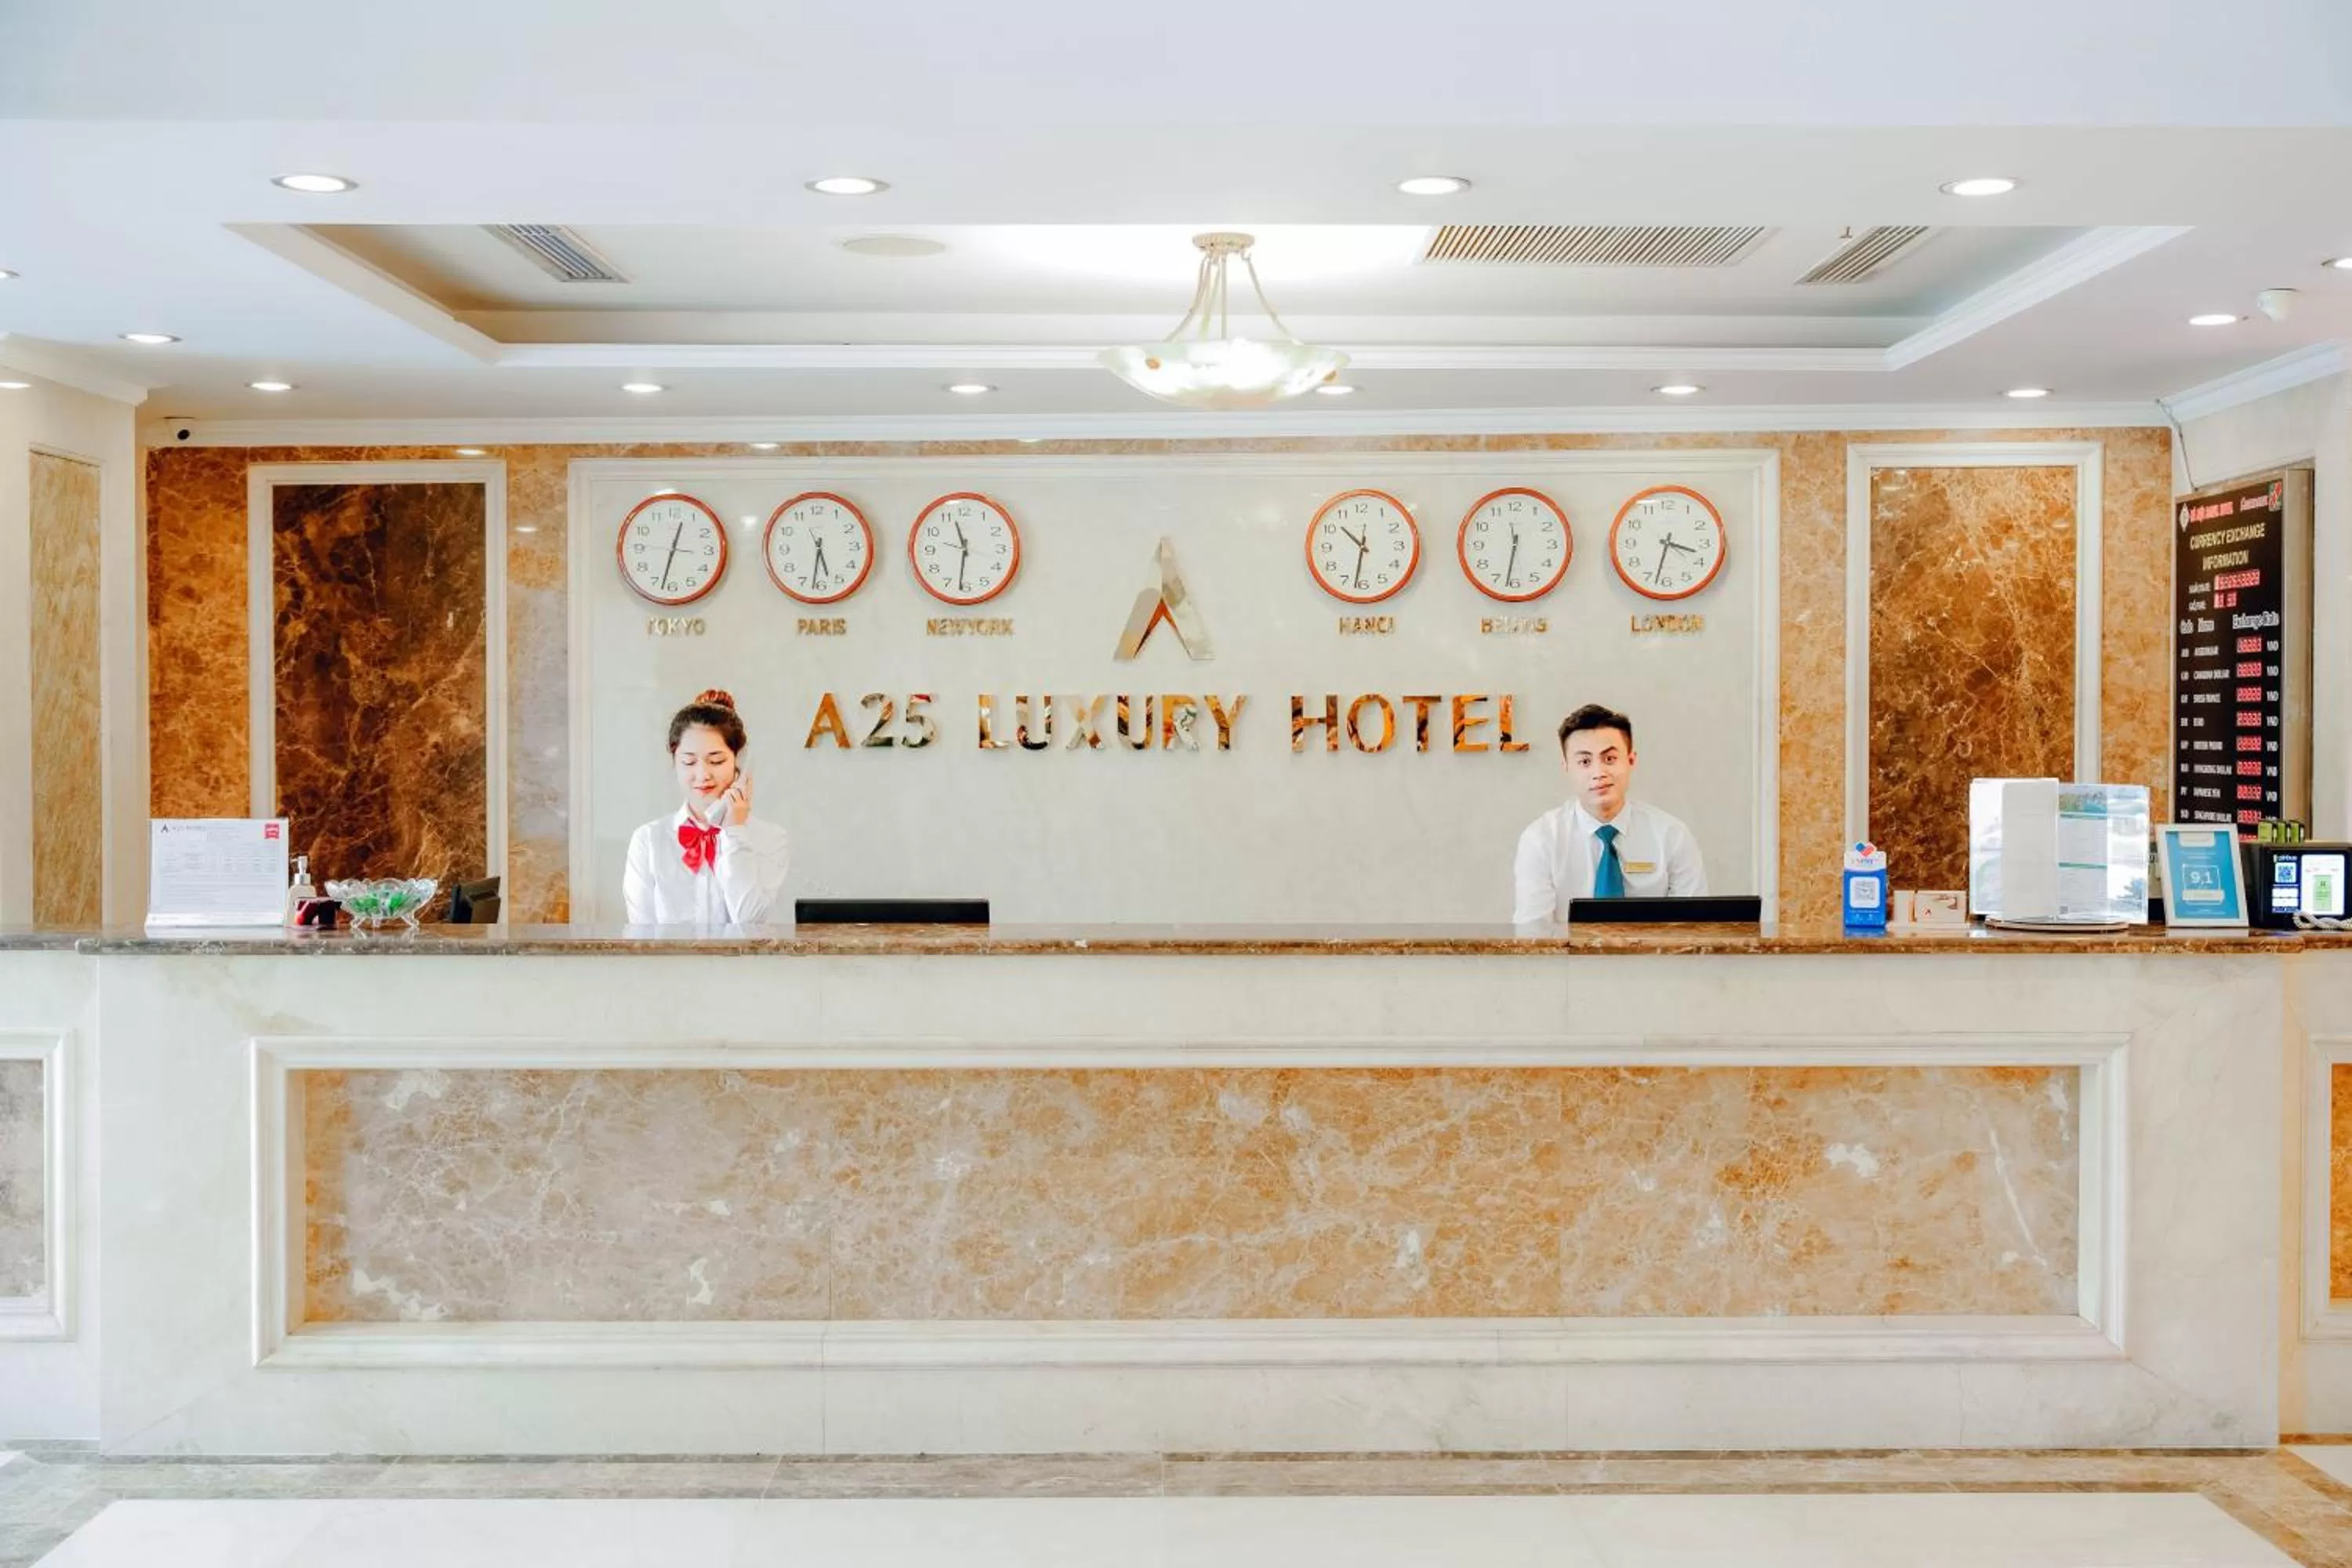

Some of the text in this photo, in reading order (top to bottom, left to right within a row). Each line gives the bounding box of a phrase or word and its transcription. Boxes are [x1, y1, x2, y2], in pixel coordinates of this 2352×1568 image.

[810, 505, 824, 515] 12
[1355, 503, 1368, 514] 12
[1508, 502, 1522, 512] 12
[1644, 505, 1653, 514] 11
[1661, 501, 1675, 510] 12
[652, 512, 662, 522] 11
[669, 508, 682, 519] 12
[794, 511, 804, 521] 11
[941, 512, 951, 522] 11
[958, 508, 971, 517] 12
[1338, 510, 1348, 518] 11
[1492, 507, 1501, 517] 11
[844, 524, 854, 534] 2
[1323, 524, 1336, 534] 10
[1388, 523, 1399, 534] 2
[1475, 521, 1489, 532] 10
[1542, 521, 1553, 532] 2
[1628, 519, 1641, 530] 10
[1694, 521, 1705, 531] 2
[637, 526, 649, 536] 10
[699, 528, 710, 539] 2
[782, 526, 793, 536] 10
[927, 527, 939, 537] 10
[991, 527, 1001, 536] 2
[849, 541, 860, 551] 3
[1321, 543, 1332, 553] 9
[1394, 540, 1404, 551] 3
[1473, 540, 1484, 550] 9
[1547, 539, 1558, 549] 3
[1625, 538, 1636, 548] 9
[1699, 539, 1709, 549] 3
[634, 543, 645, 554] 9
[704, 545, 714, 556] 3
[779, 543, 790, 555] 9
[925, 545, 935, 556] 9
[996, 543, 1006, 554] 3
[637, 562, 648, 572] 8
[846, 560, 856, 569] 4
[991, 562, 1002, 571] 4
[1326, 561, 1337, 572] 8
[1388, 559, 1399, 569] 4
[1476, 559, 1488, 569] 8
[1541, 558, 1552, 568] 4
[1628, 557, 1640, 567] 8
[1693, 557, 1704, 567] 4
[784, 563, 795, 573] 8
[928, 564, 940, 574] 8
[651, 577, 659, 586] 7
[798, 576, 807, 586] 7
[834, 575, 844, 584] 5
[980, 577, 989, 586] 5
[1340, 575, 1348, 585] 7
[1377, 574, 1388, 584] 5
[1491, 574, 1501, 583] 7
[1530, 572, 1540, 582] 5
[1643, 572, 1653, 581] 7
[1681, 571, 1692, 582] 5
[667, 582, 678, 592] 6
[686, 577, 696, 587] 5
[815, 580, 826, 590] 6
[943, 577, 952, 587] 7
[1358, 580, 1370, 590] 6
[1509, 579, 1520, 588] 6
[1661, 577, 1672, 587] 6
[647, 618, 706, 635] TOKYO
[797, 619, 846, 635] PARIS
[1631, 615, 1705, 632] LONDON
[804, 692, 1530, 753] A25 LUXURY HOTEL
[2190, 872, 2213, 884] 9,1
